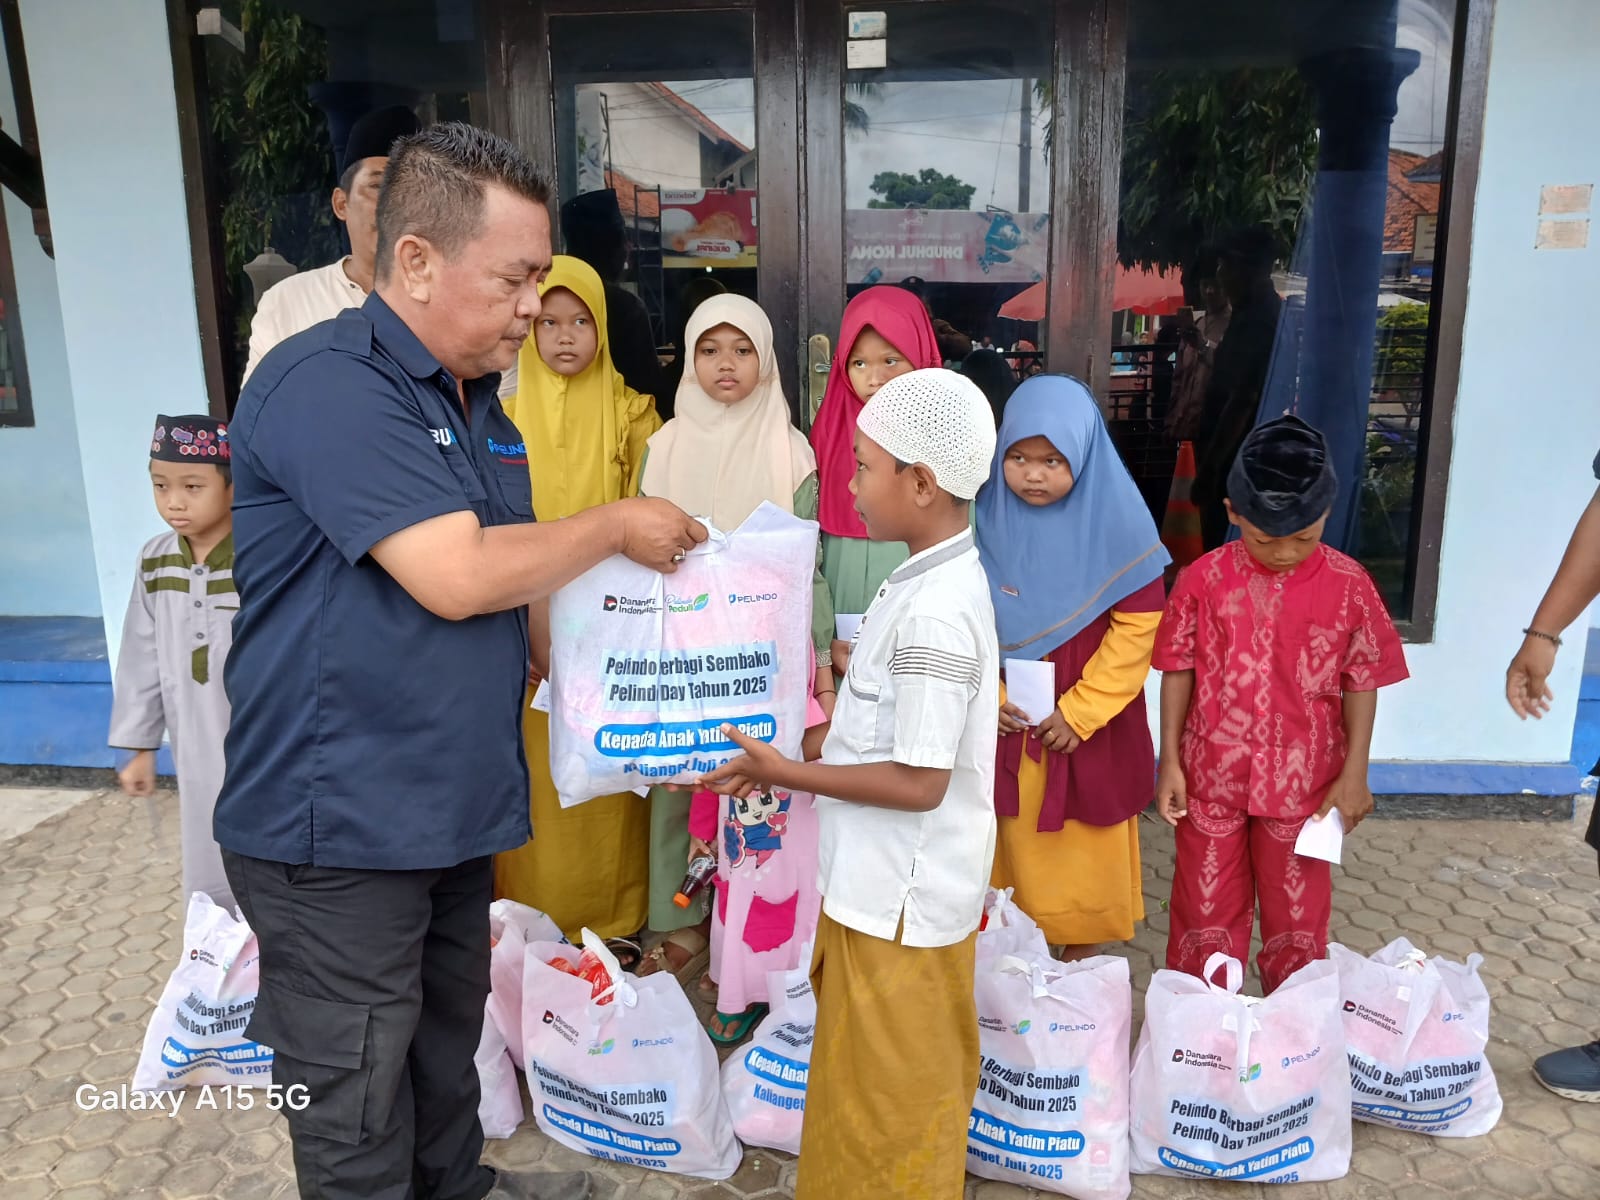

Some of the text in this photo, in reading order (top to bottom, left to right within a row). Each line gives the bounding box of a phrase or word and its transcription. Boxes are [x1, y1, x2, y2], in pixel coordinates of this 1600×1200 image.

[737, 593, 778, 603] PELINDO
[605, 657, 657, 675] Pelindo
[706, 651, 770, 671] Sembako
[660, 684, 685, 701] Day
[688, 681, 730, 699] Tahun
[733, 676, 767, 696] 2025
[601, 730, 657, 751] Kepada
[658, 729, 694, 748] Anak
[190, 1020, 207, 1036] Day
[209, 1016, 247, 1034] Tahun
[1356, 1011, 1392, 1032] Indonesia
[1358, 1004, 1397, 1026] Danantara
[1058, 1023, 1096, 1032] PELINDO
[639, 1037, 674, 1047] PELINDO
[984, 1058, 1026, 1087] Berbagi
[1026, 1072, 1080, 1090] Sembako
[1424, 1060, 1481, 1080] Sembako
[611, 1088, 667, 1106] Sembako
[988, 1079, 1008, 1102] Day
[1008, 1089, 1045, 1112] Tahun
[1048, 1096, 1077, 1113] 2025
[1410, 1087, 1446, 1103] Tahun
[633, 1111, 664, 1126] 2025
[1170, 1096, 1314, 1132] Pelindo Berbagi Sembako
[1370, 1106, 1404, 1119] Anak
[583, 1121, 611, 1141] Anak
[611, 1130, 643, 1151] Yatim
[644, 1140, 678, 1152] Piatu
[975, 1117, 1007, 1143] Anak
[1008, 1129, 1045, 1151] Yatim
[1047, 1136, 1081, 1152] Piatu
[1172, 1113, 1308, 1150] Pelindo Day Tahun 2025
[635, 1157, 667, 1168] 2025
[1004, 1156, 1027, 1172] Juli
[1030, 1163, 1063, 1180] 2025
[1162, 1141, 1311, 1178] Kepada Anak Yatim Piatu
